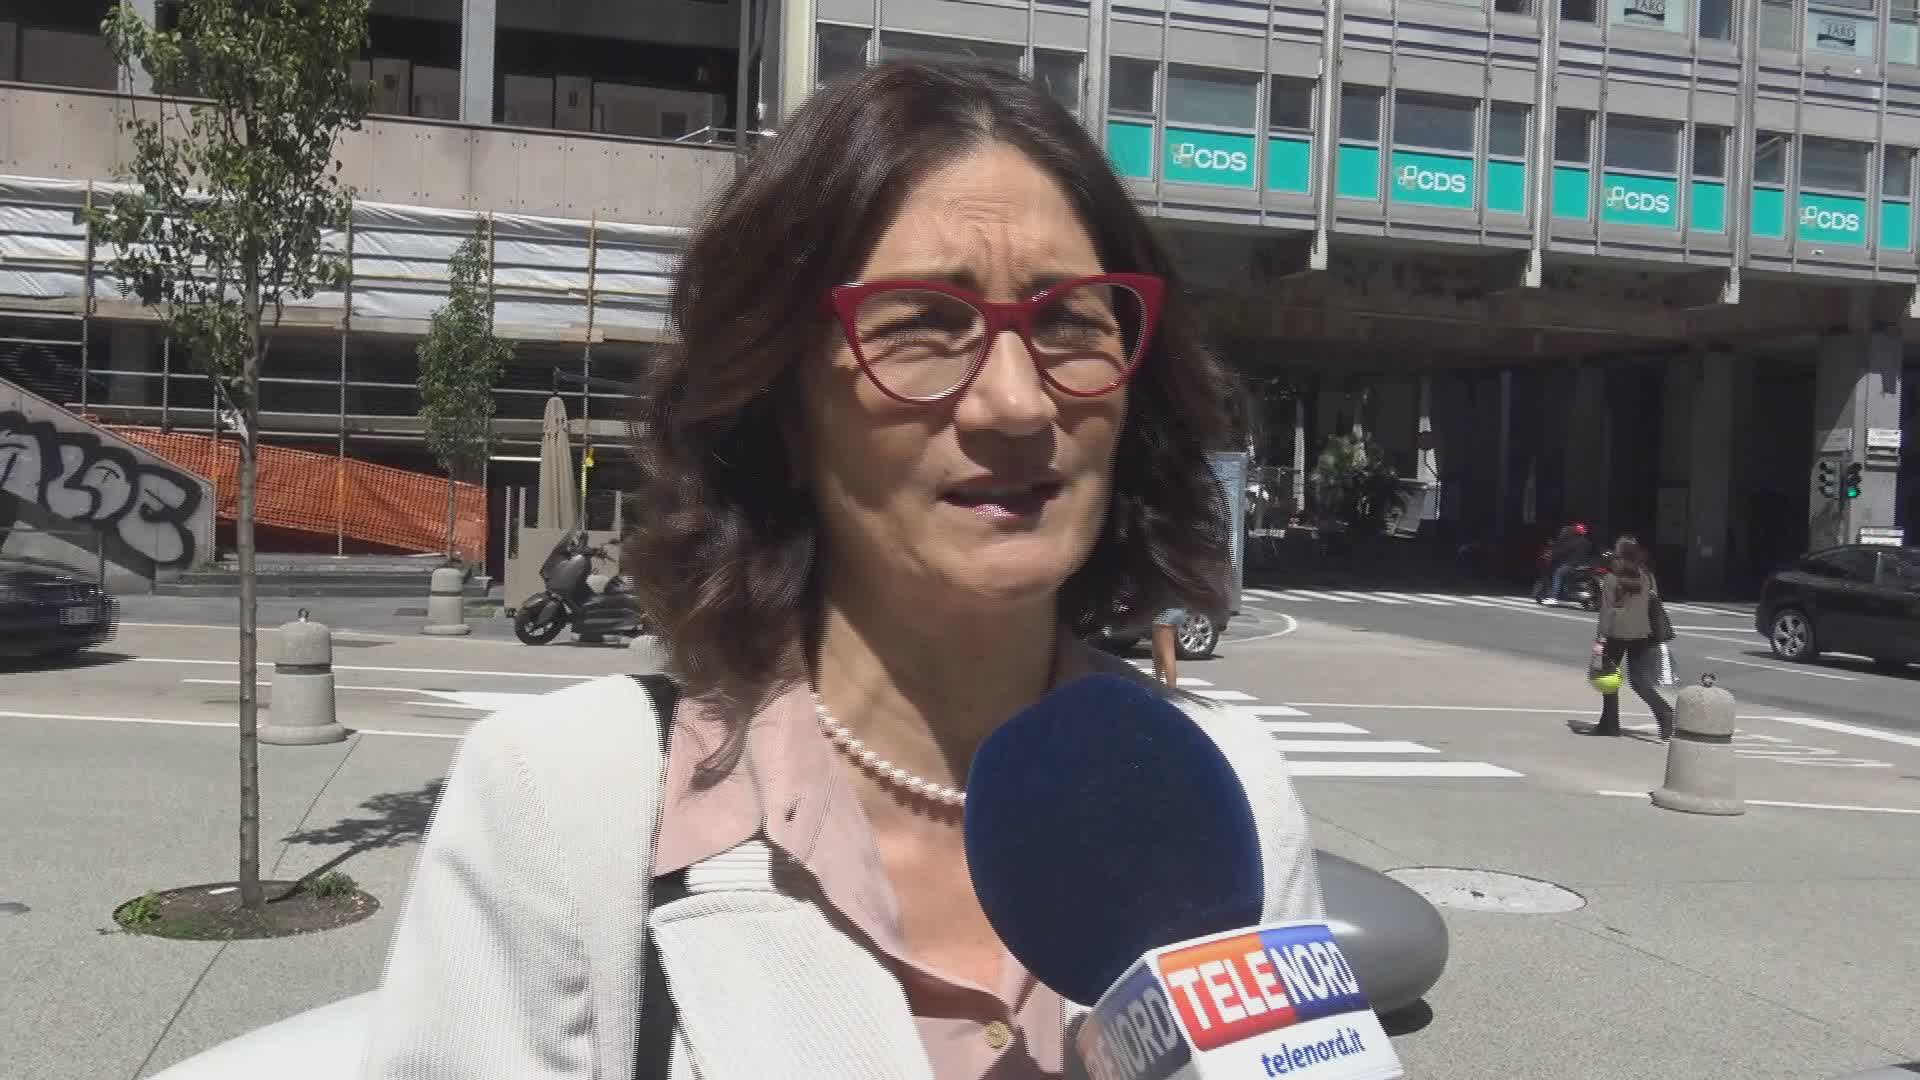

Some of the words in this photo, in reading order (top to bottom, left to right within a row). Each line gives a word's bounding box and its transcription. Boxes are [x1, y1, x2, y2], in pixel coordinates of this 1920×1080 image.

[1195, 149, 1247, 171] CDS
[1418, 171, 1466, 192] CDS
[1624, 192, 1670, 213] CDS
[1817, 211, 1859, 231] CDS
[1262, 1026, 1366, 1077] telenord.it
